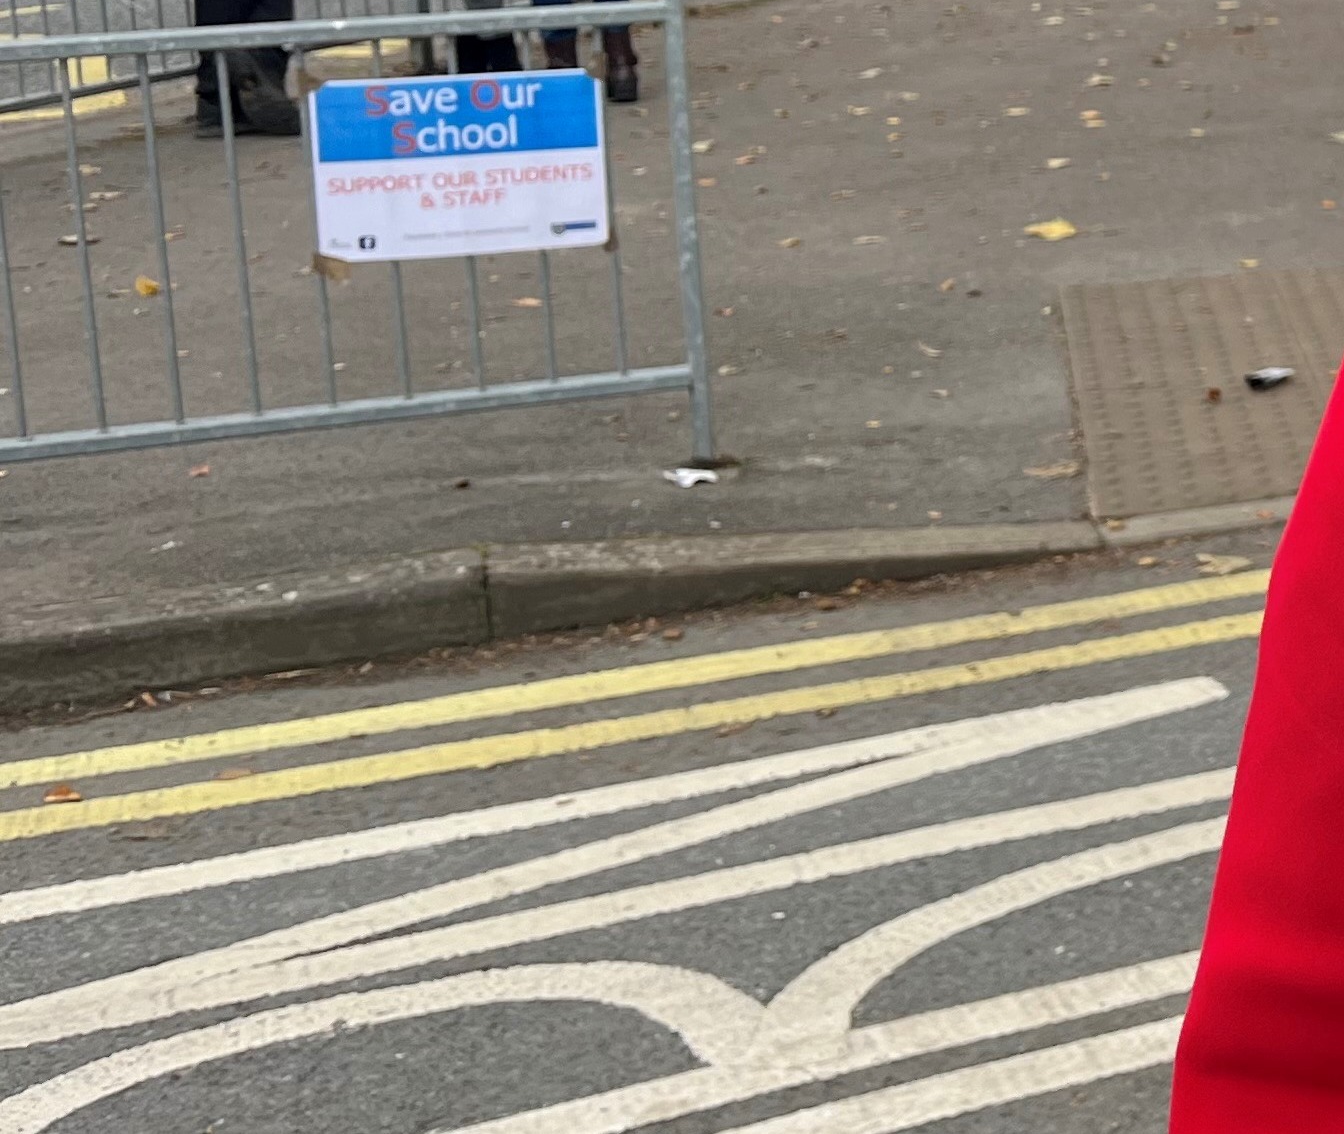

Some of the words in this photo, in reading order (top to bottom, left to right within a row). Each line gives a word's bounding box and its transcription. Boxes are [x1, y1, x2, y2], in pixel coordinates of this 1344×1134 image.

[365, 83, 458, 116] Save
[470, 79, 542, 111] Our
[392, 114, 519, 154] School
[327, 173, 423, 195] SUPPORT
[432, 170, 478, 190] OUR
[486, 163, 594, 183] STUDENTS
[420, 192, 435, 209] &
[442, 188, 508, 208] STAFF
